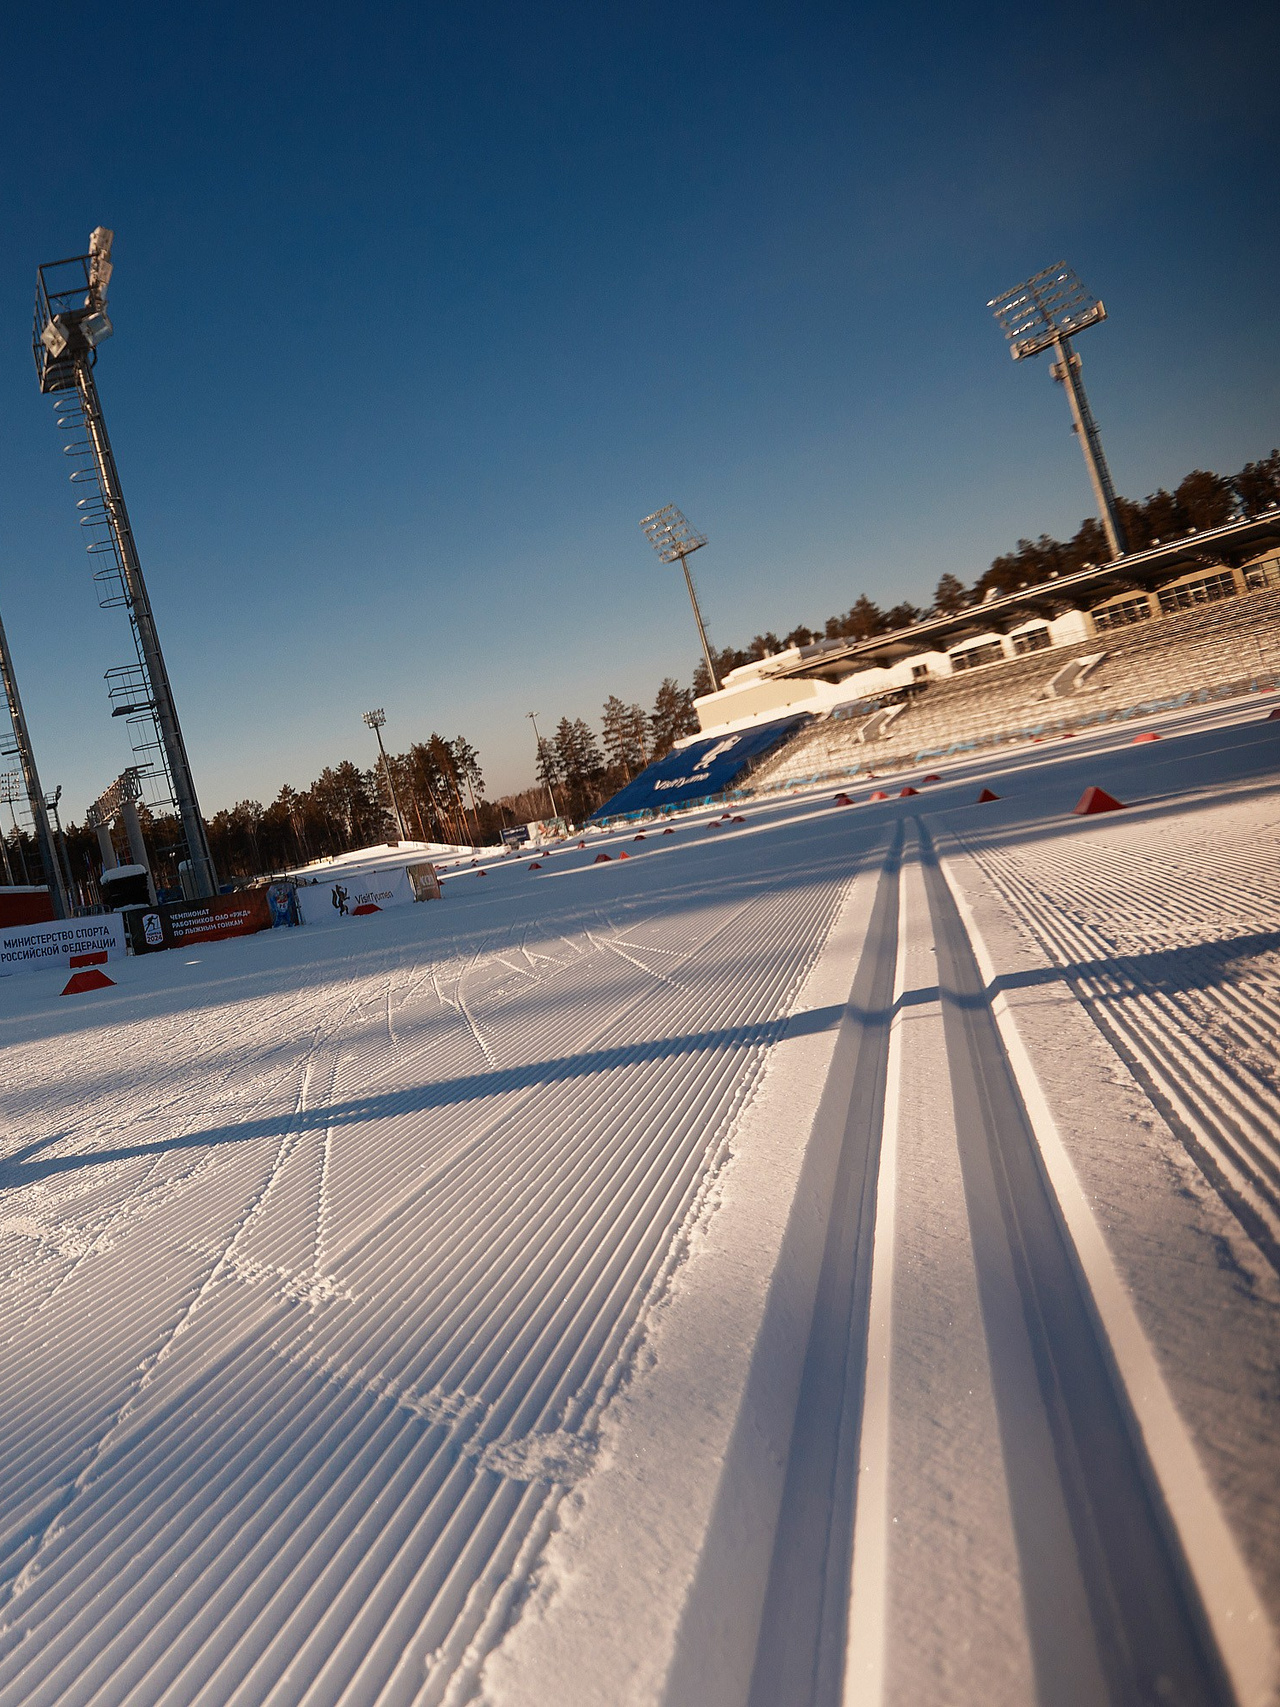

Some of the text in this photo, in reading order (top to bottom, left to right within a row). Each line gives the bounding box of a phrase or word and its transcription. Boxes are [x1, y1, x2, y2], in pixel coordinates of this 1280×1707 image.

[354, 890, 394, 904] VisitTyumen
[169, 908, 210, 921] ЧЕМПИОНАТ
[171, 914, 214, 929] РАБОТНИКОВ
[173, 928, 184, 937] ПО
[184, 923, 217, 935] ЛЫЖНЫМ
[217, 918, 244, 930] ГОНКАМ
[3, 925, 110, 950] МИНИСТЕРСТВО СПОРТА
[0, 937, 117, 963] РОССИЙСКОЙ ФЕДЕРАЦИИ
